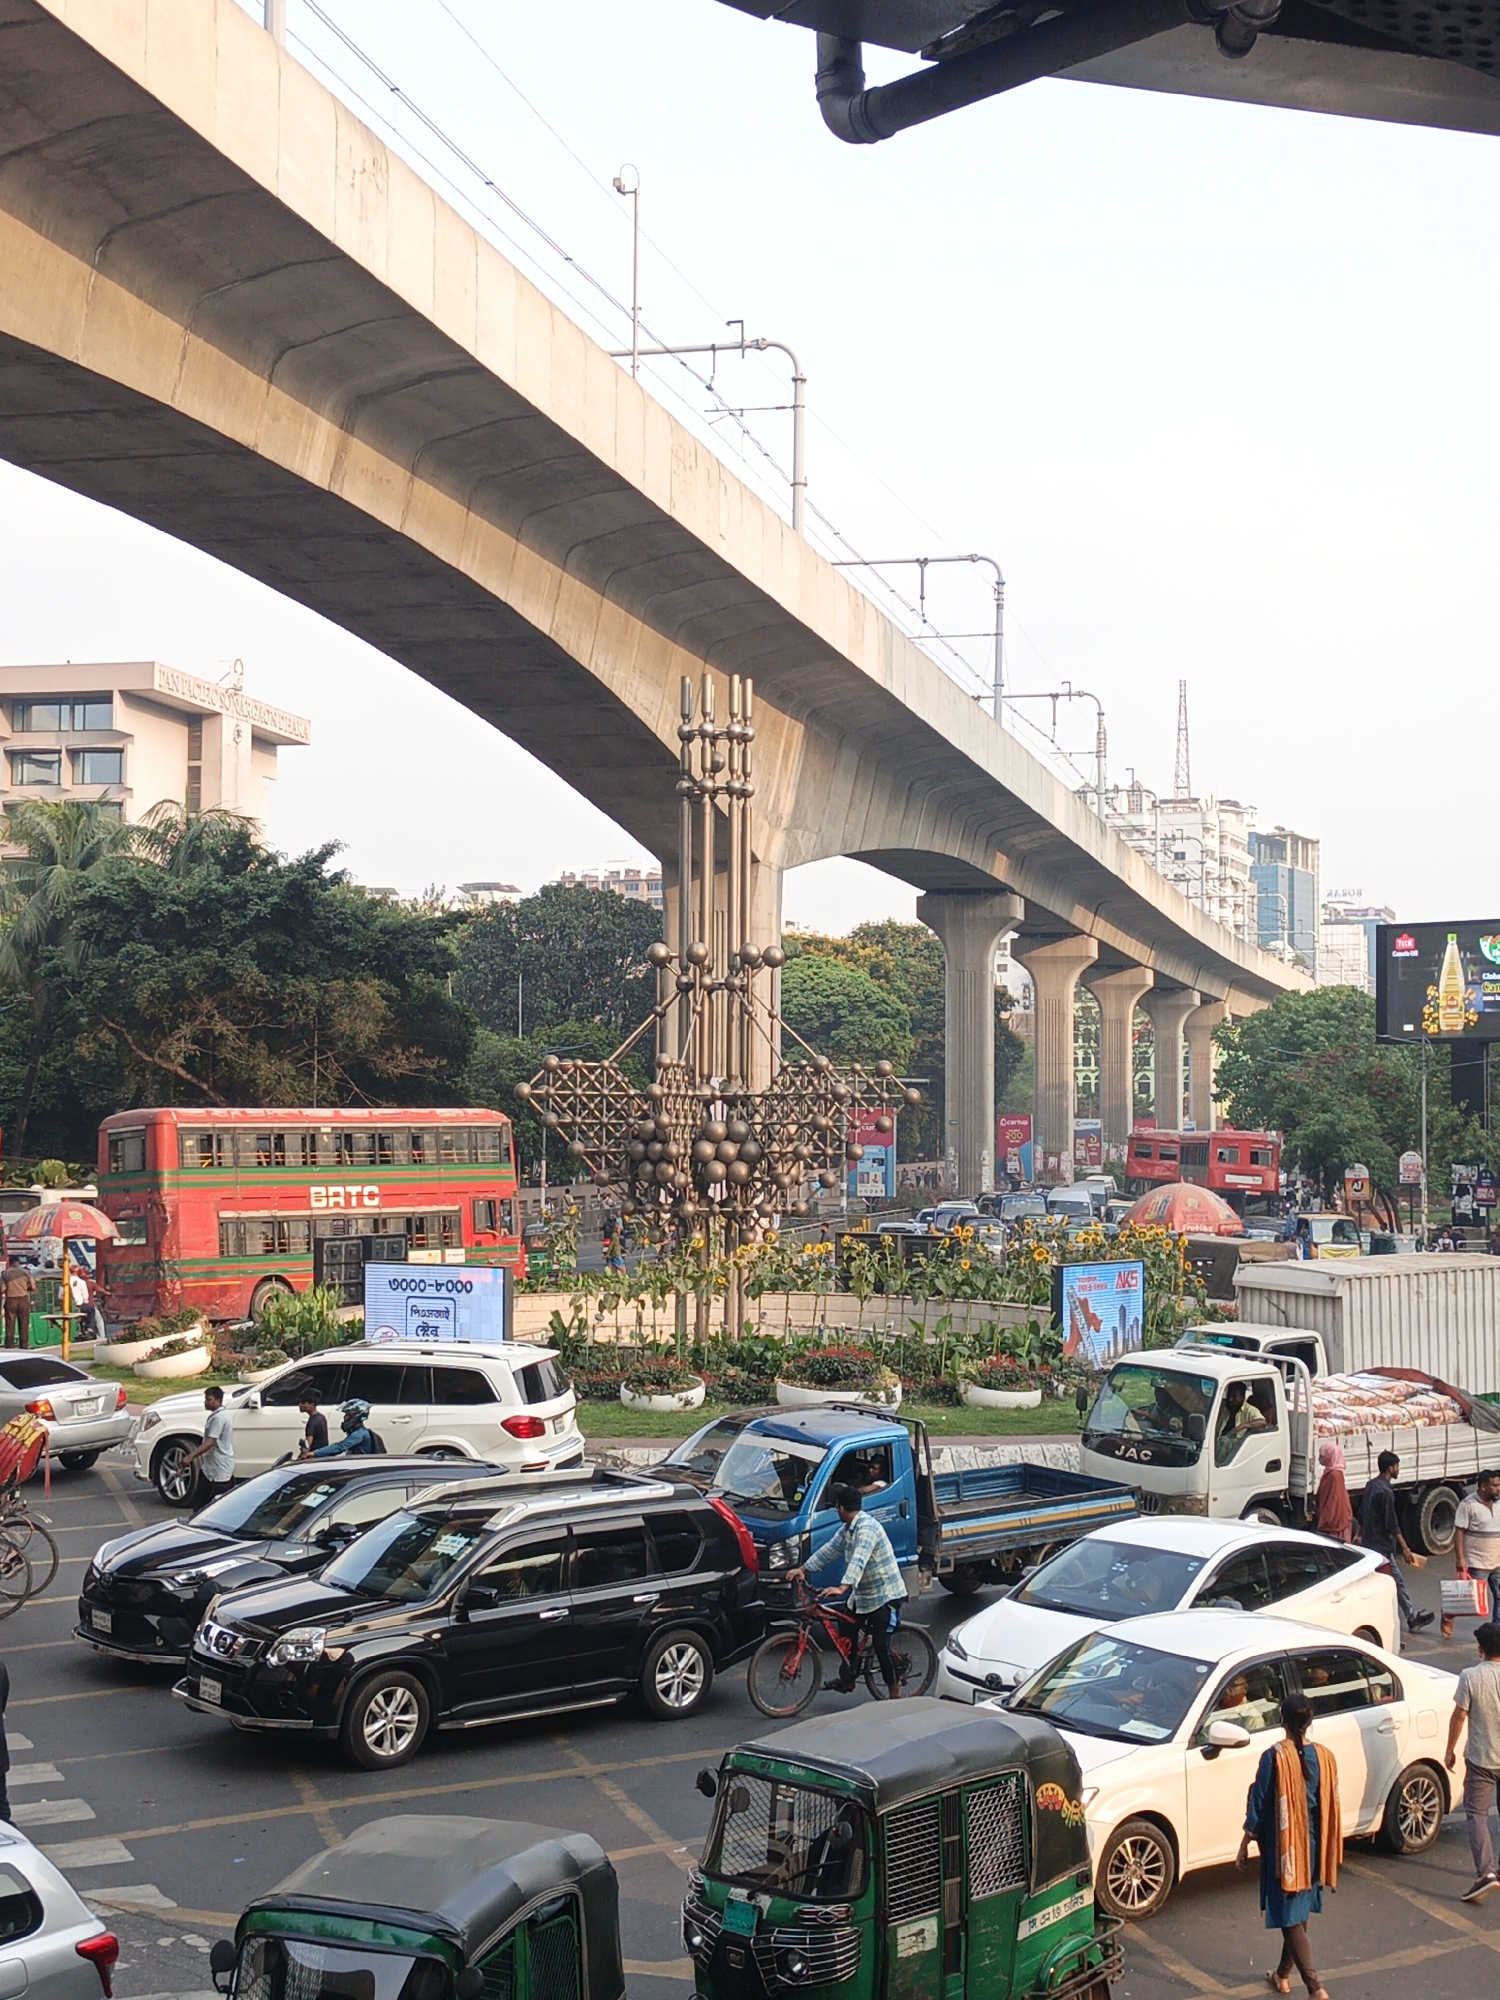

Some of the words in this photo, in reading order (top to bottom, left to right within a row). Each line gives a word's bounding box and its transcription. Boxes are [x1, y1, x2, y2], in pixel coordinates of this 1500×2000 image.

[158, 669, 179, 692] PAN
[181, 676, 218, 707] PACIFIC
[218, 689, 278, 731] SONARGAON
[278, 712, 310, 740] DHAKA
[310, 1185, 380, 1207] BRTC
[388, 1278, 473, 1294] ৩০০০-৮০০০
[1115, 1270, 1138, 1289] AKS
[1114, 1445, 1152, 1461] JAC
